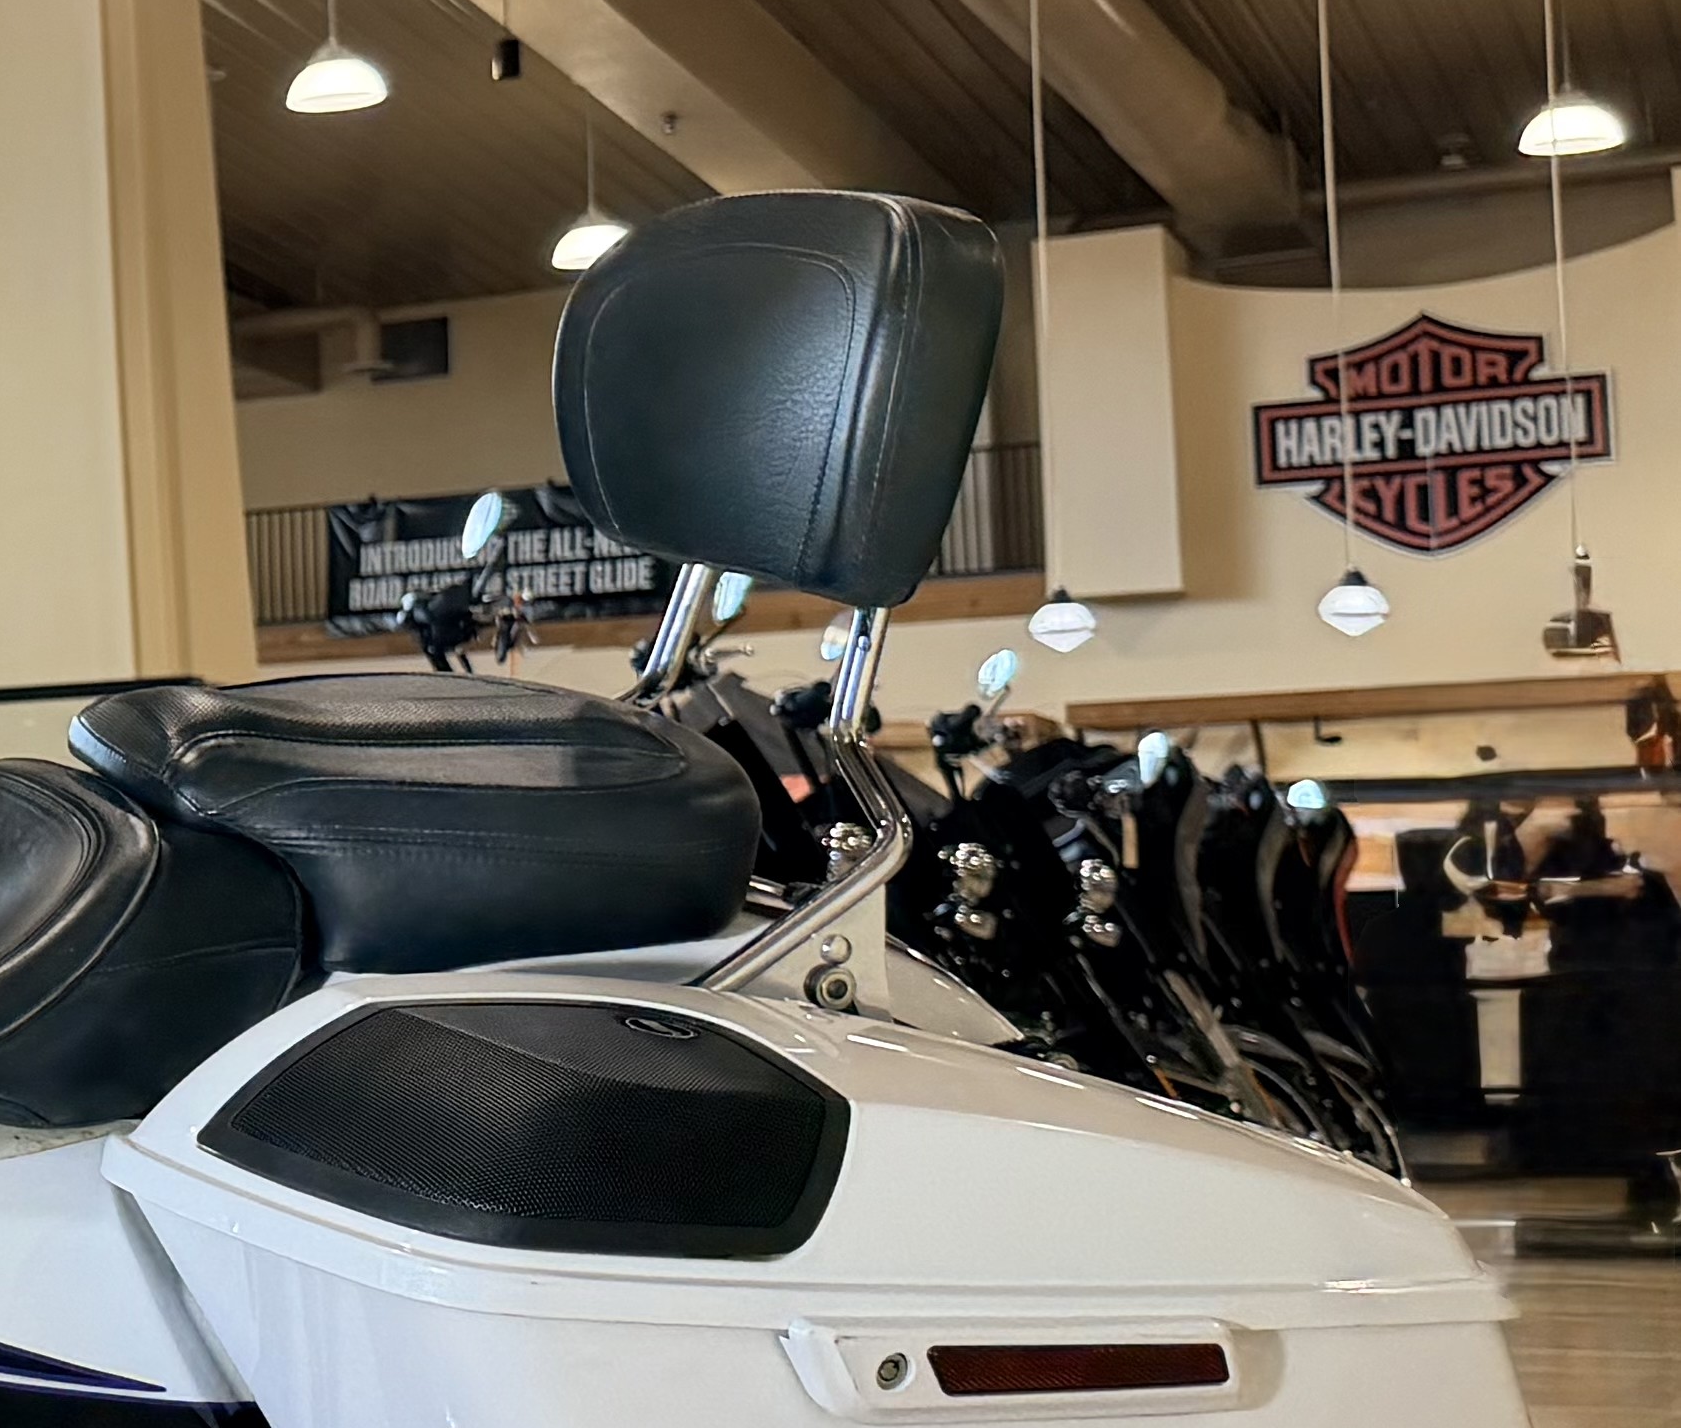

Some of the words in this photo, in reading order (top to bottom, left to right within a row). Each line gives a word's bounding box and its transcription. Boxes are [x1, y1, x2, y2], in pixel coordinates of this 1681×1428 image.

[1349, 337, 1511, 397] MOTOR
[1274, 394, 1588, 468] HARLEY-DAVIDSON
[1350, 468, 1516, 534] CYCLES
[359, 531, 504, 575] INTRODUC
[507, 529, 548, 565] THE
[348, 575, 405, 612] ROAD
[506, 562, 586, 599] STREET
[589, 555, 655, 594] GLIDE
